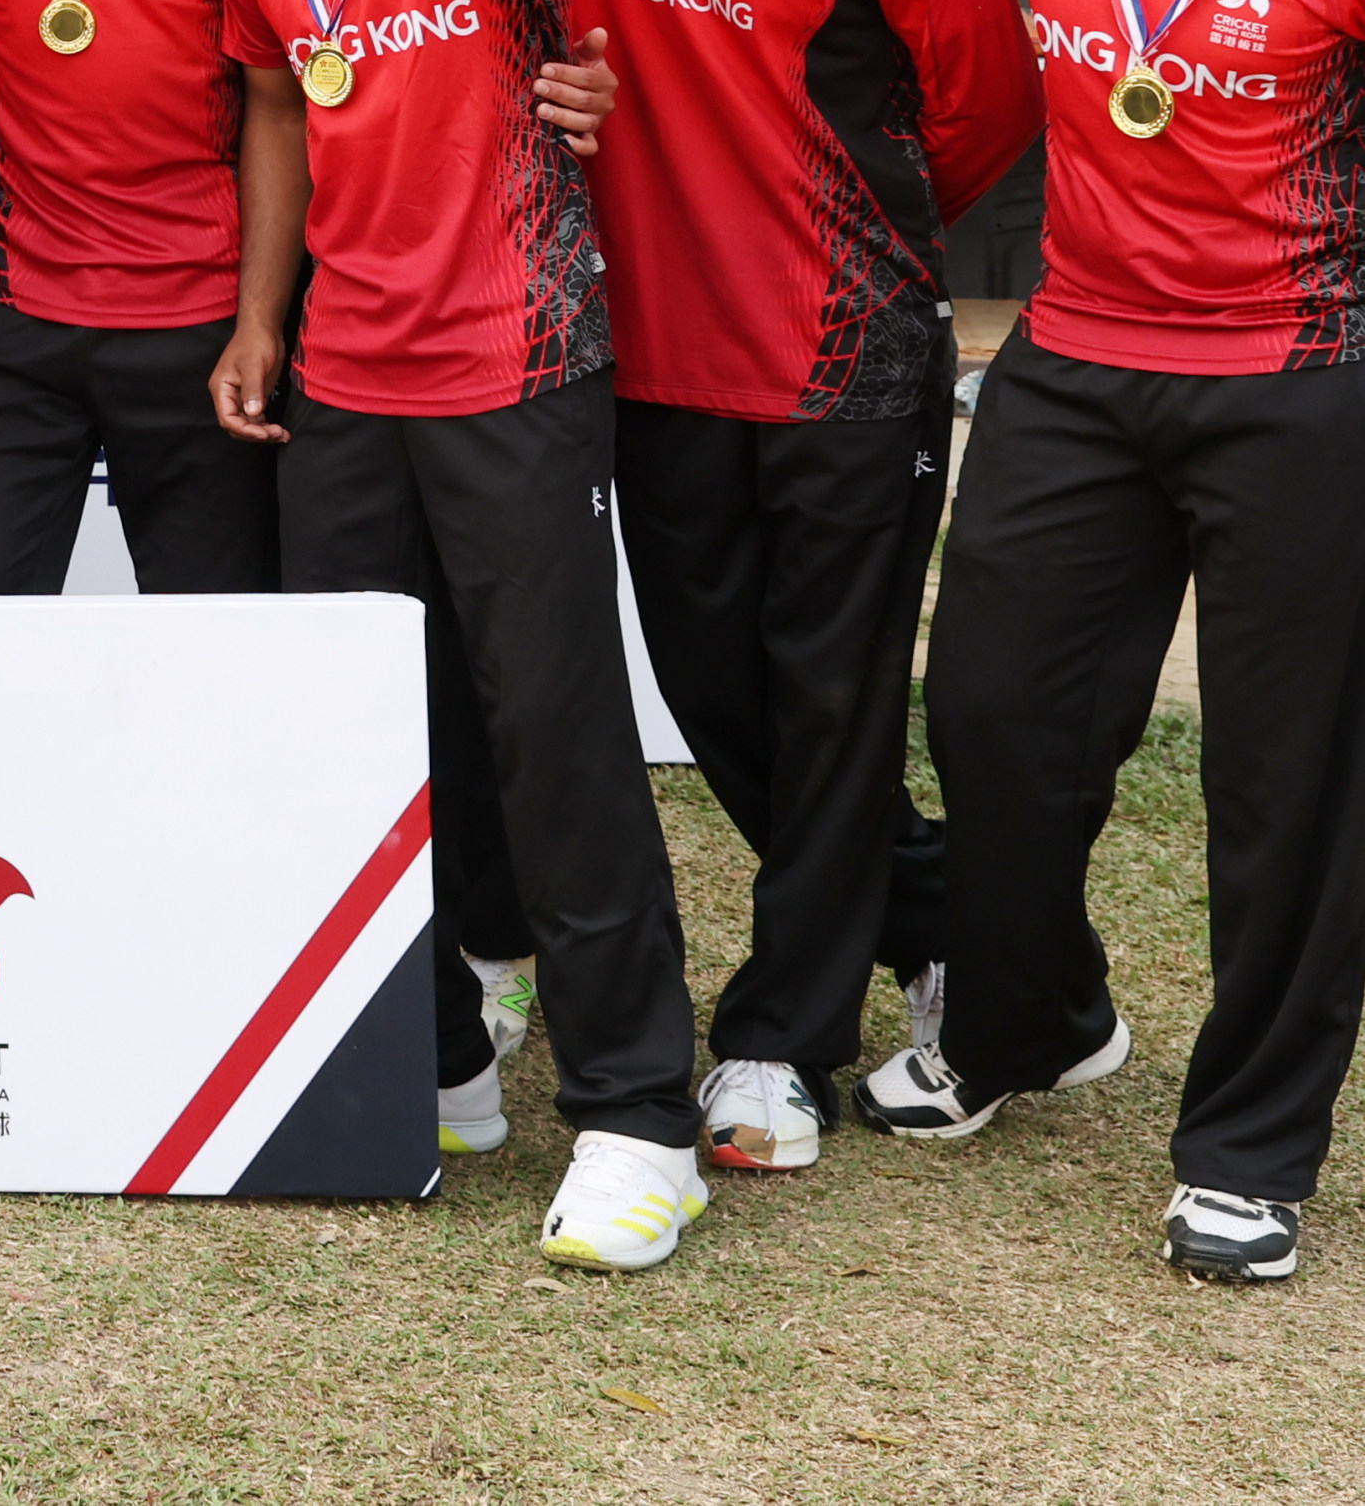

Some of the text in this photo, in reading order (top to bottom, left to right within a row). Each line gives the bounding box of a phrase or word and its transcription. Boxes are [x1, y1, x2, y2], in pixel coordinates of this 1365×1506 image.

[1211, 23, 1268, 42] HONG KONG
[1213, 13, 1269, 35] CRICKET
[1033, 12, 1116, 72] ONG
